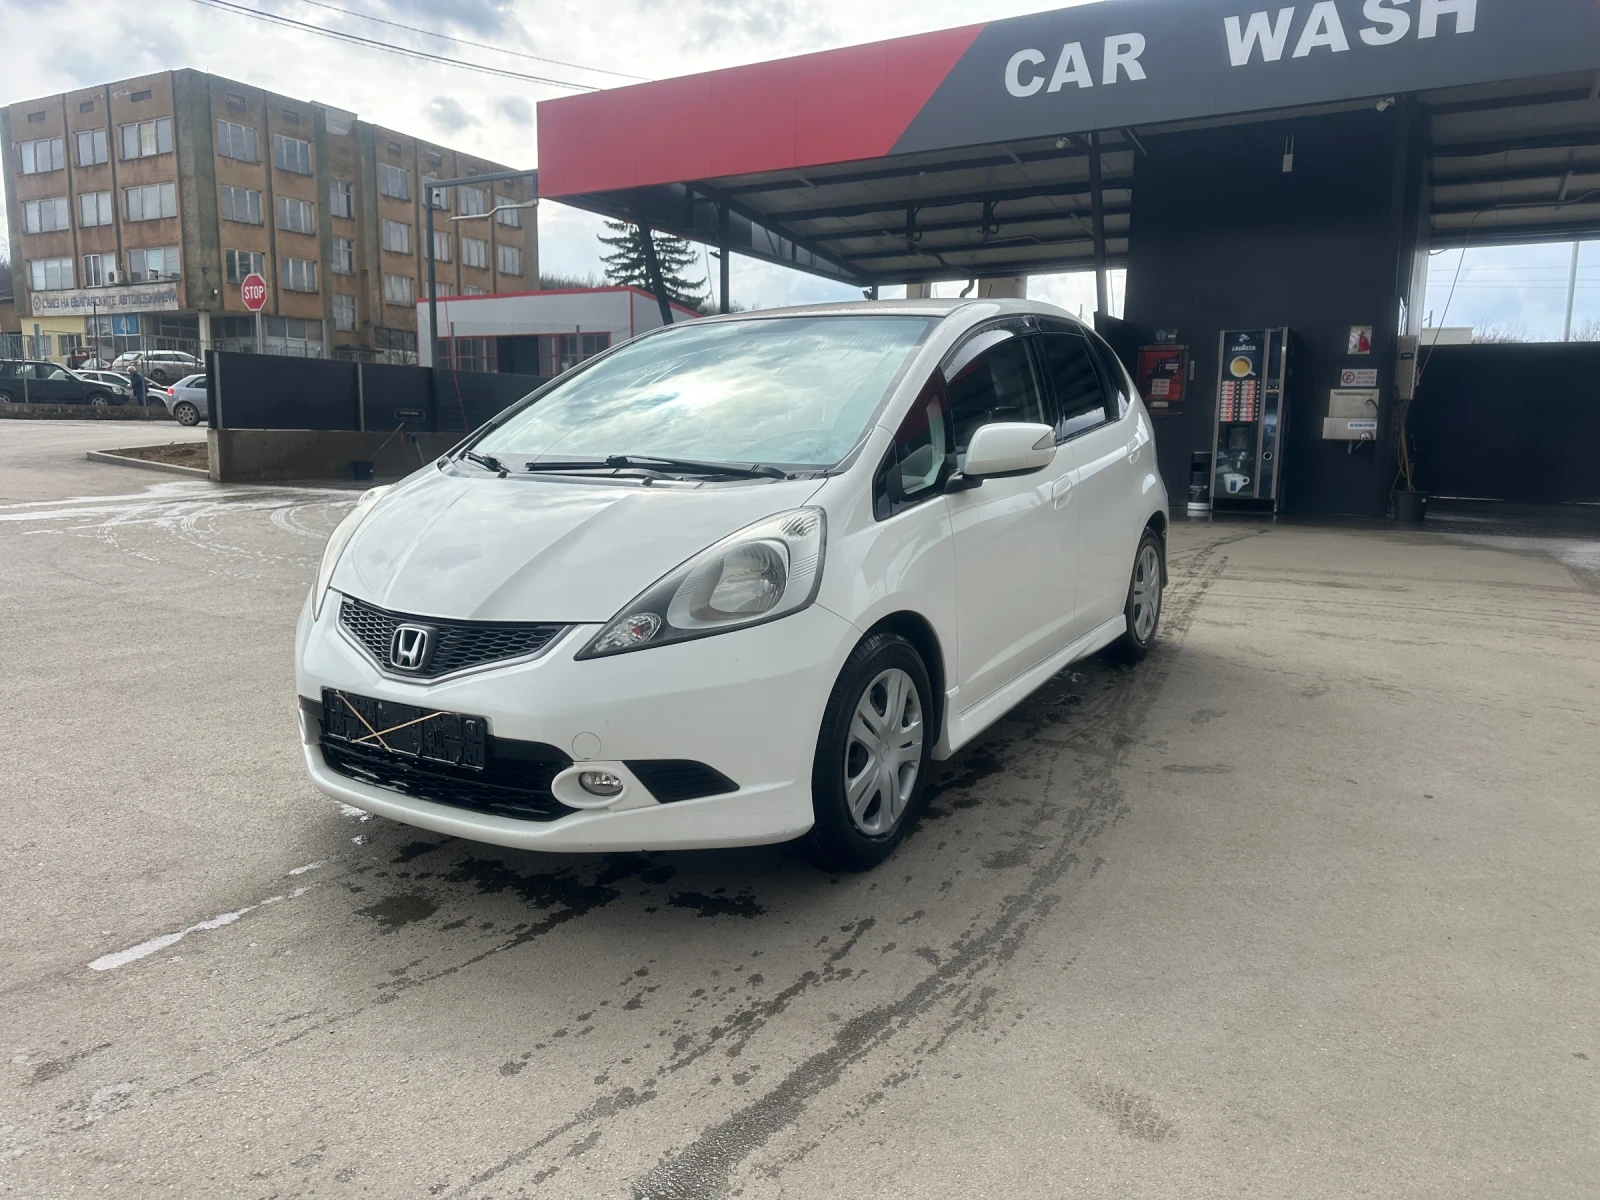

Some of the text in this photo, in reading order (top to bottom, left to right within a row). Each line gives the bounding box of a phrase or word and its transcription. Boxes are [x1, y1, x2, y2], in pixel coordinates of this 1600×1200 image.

[1004, 0, 1477, 98] CAR WASH
[244, 285, 264, 300] STOP
[61, 297, 70, 309] НА
